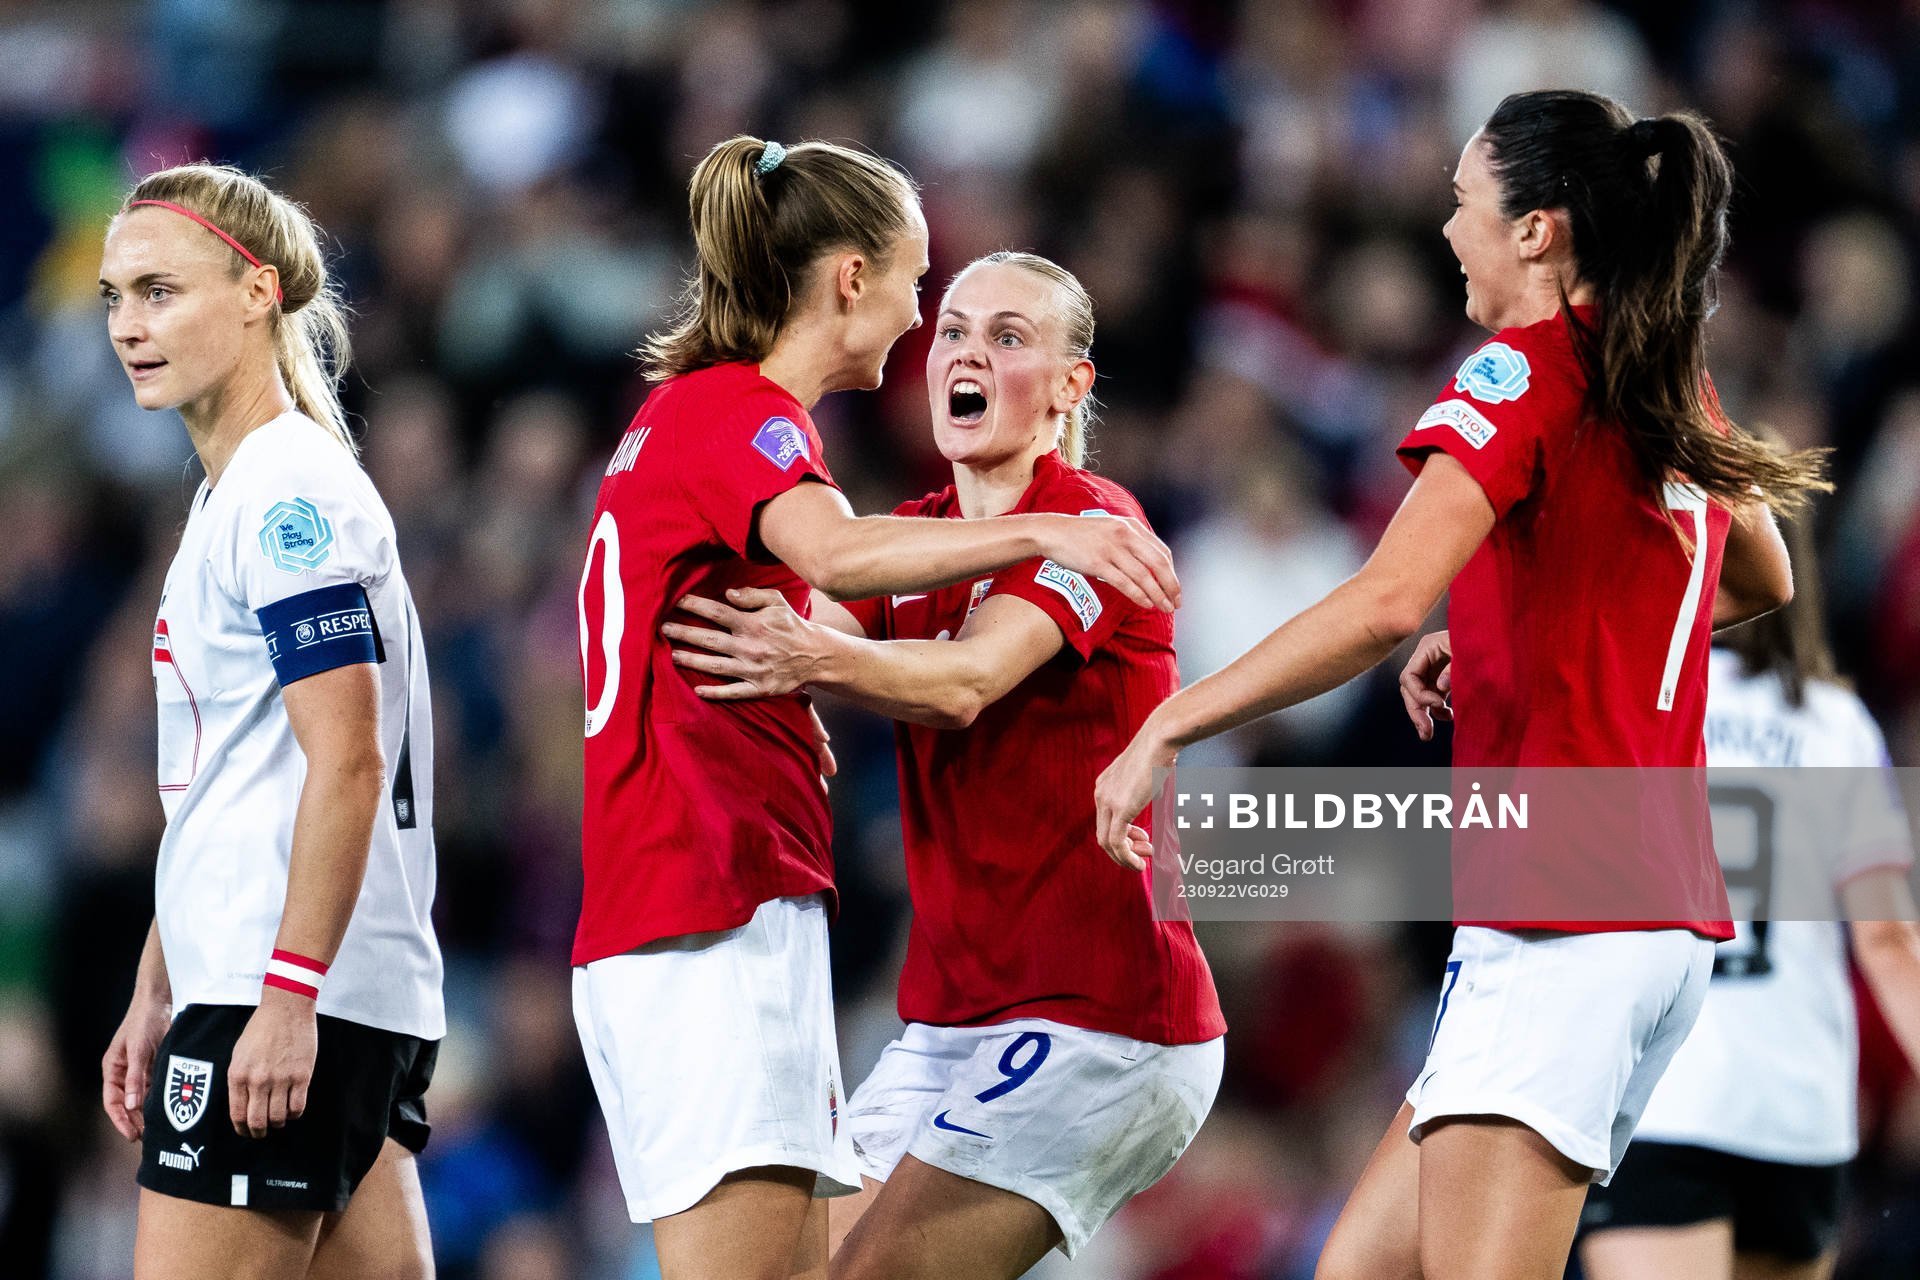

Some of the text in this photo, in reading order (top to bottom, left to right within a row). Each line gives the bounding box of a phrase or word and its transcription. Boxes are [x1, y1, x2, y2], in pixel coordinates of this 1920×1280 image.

[280, 523, 294, 532] We
[284, 538, 314, 549] Strong
[1657, 482, 1708, 712] 7
[1428, 961, 1463, 1056] 7
[974, 1031, 1052, 1104] 9
[158, 1150, 193, 1171] PUMA
